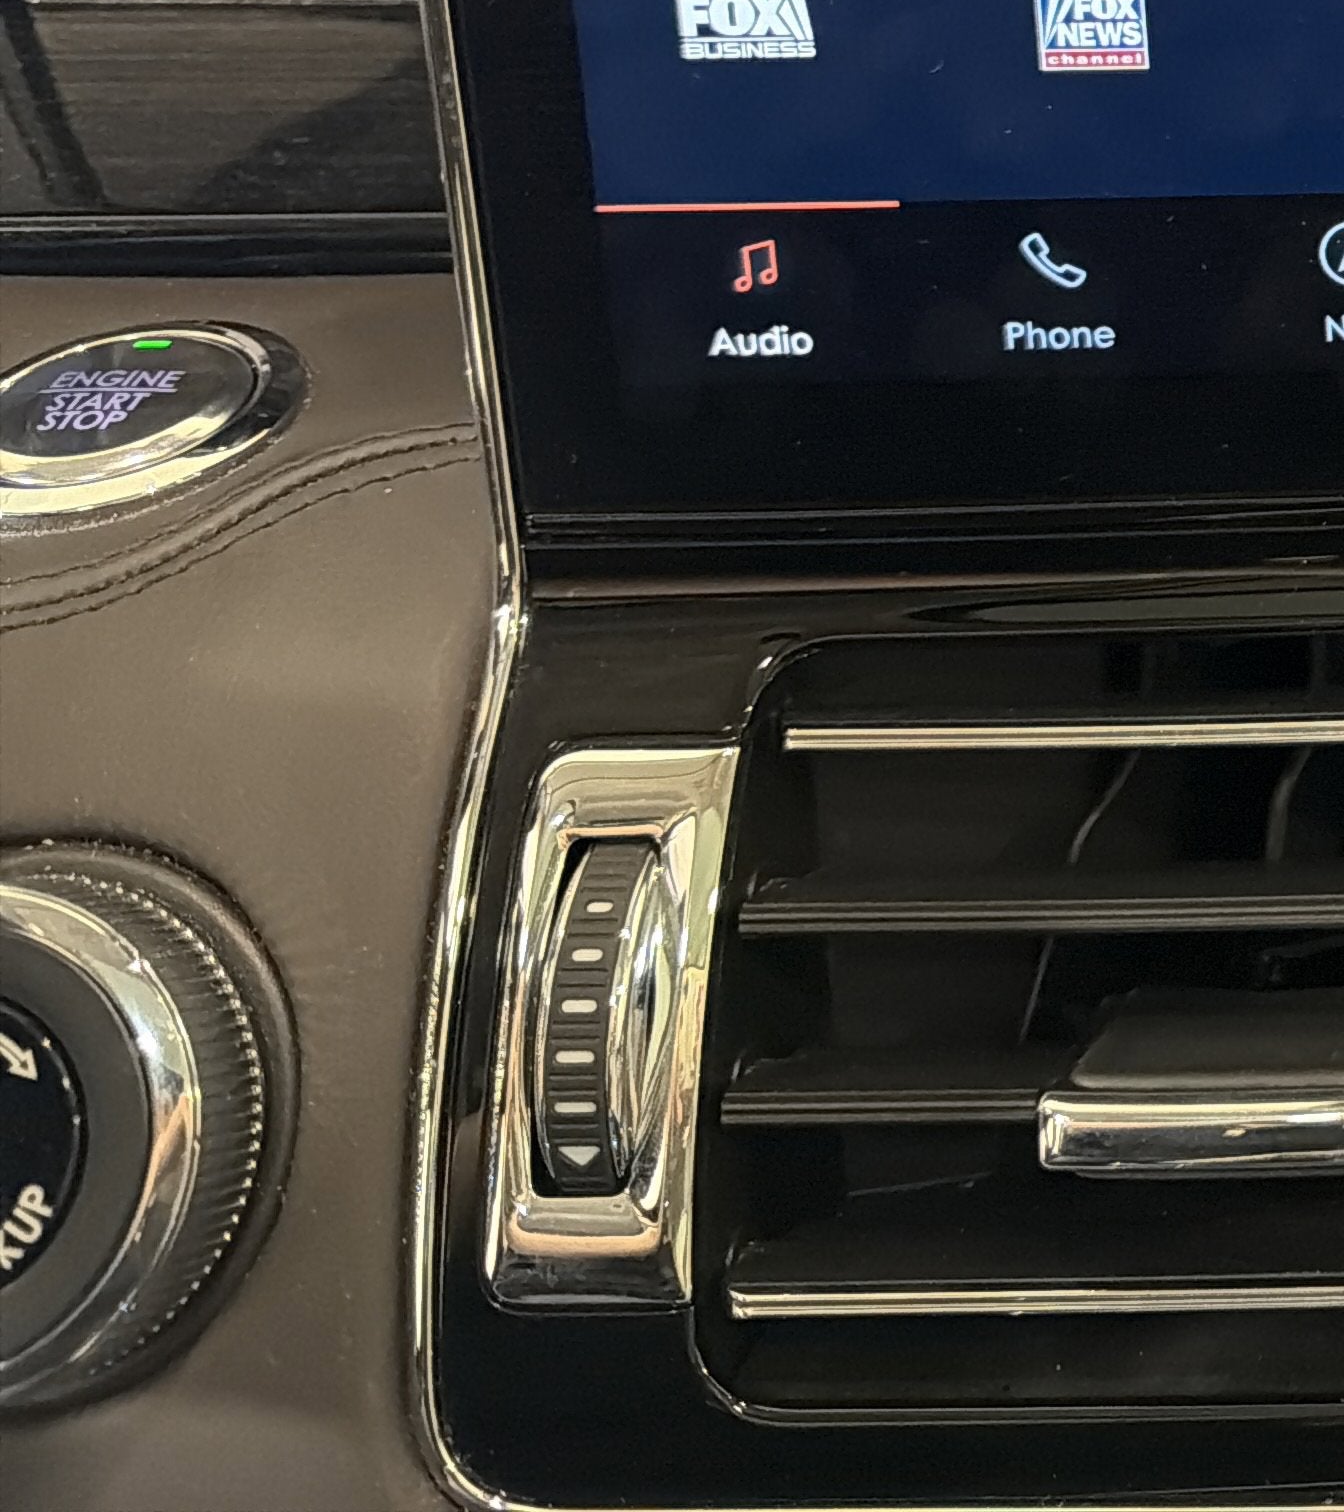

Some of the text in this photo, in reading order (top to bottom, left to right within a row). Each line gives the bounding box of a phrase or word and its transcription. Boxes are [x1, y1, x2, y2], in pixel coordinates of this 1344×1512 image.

[1056, 21, 1142, 47] NEWS
[680, 41, 816, 59] BUSINESS
[1047, 53, 1142, 65] channel
[708, 324, 814, 357] Audio
[1003, 320, 1116, 350] Phone
[51, 370, 186, 388] ENGINE
[46, 392, 153, 411] START
[36, 410, 129, 431] STOP
